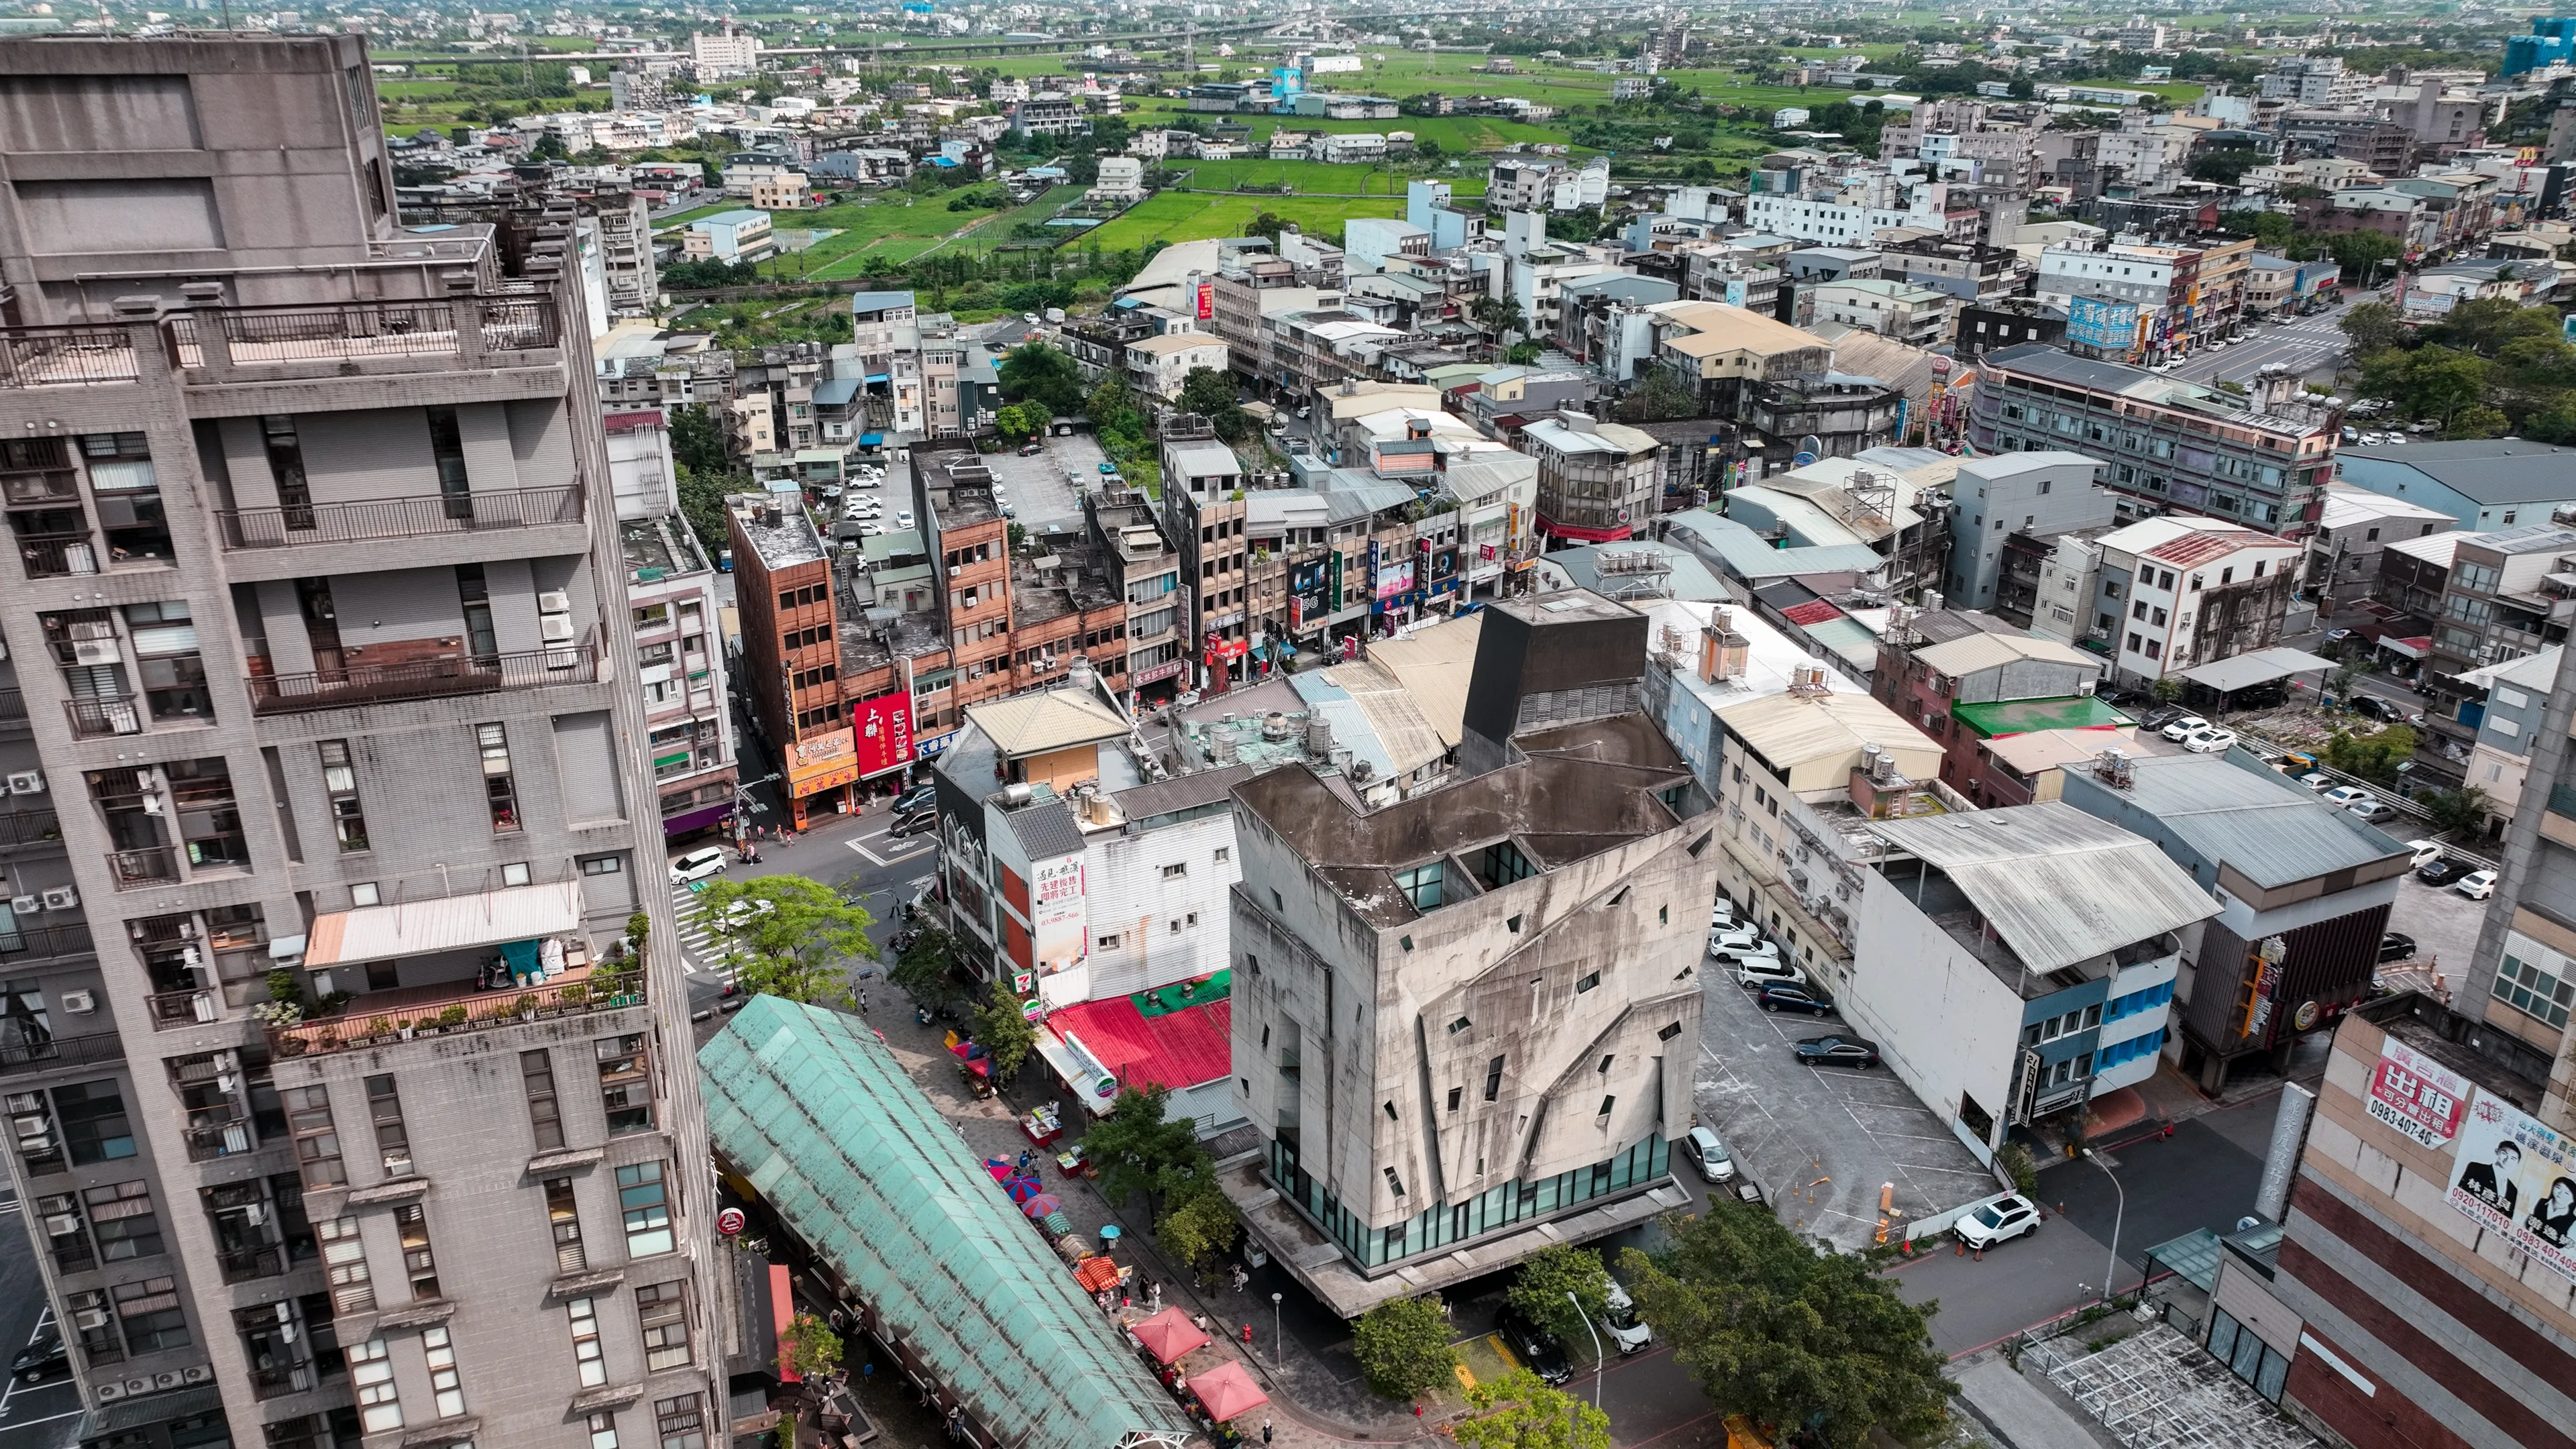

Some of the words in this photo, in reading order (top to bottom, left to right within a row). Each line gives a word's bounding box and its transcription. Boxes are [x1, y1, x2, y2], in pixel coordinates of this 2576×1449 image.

[1303, 596, 1318, 611] 5G
[865, 708, 879, 738] 上聯
[800, 772, 855, 795] 阿萬之家
[1040, 875, 1077, 892] 先建後售
[1040, 885, 1077, 901] 即將完工
[2393, 1044, 2459, 1092] 廣告牆
[2384, 1064, 2454, 1121] 出租
[2371, 1099, 2438, 1146] 0983-407-40
[2515, 1130, 2564, 1167] 礁溪溫泉
